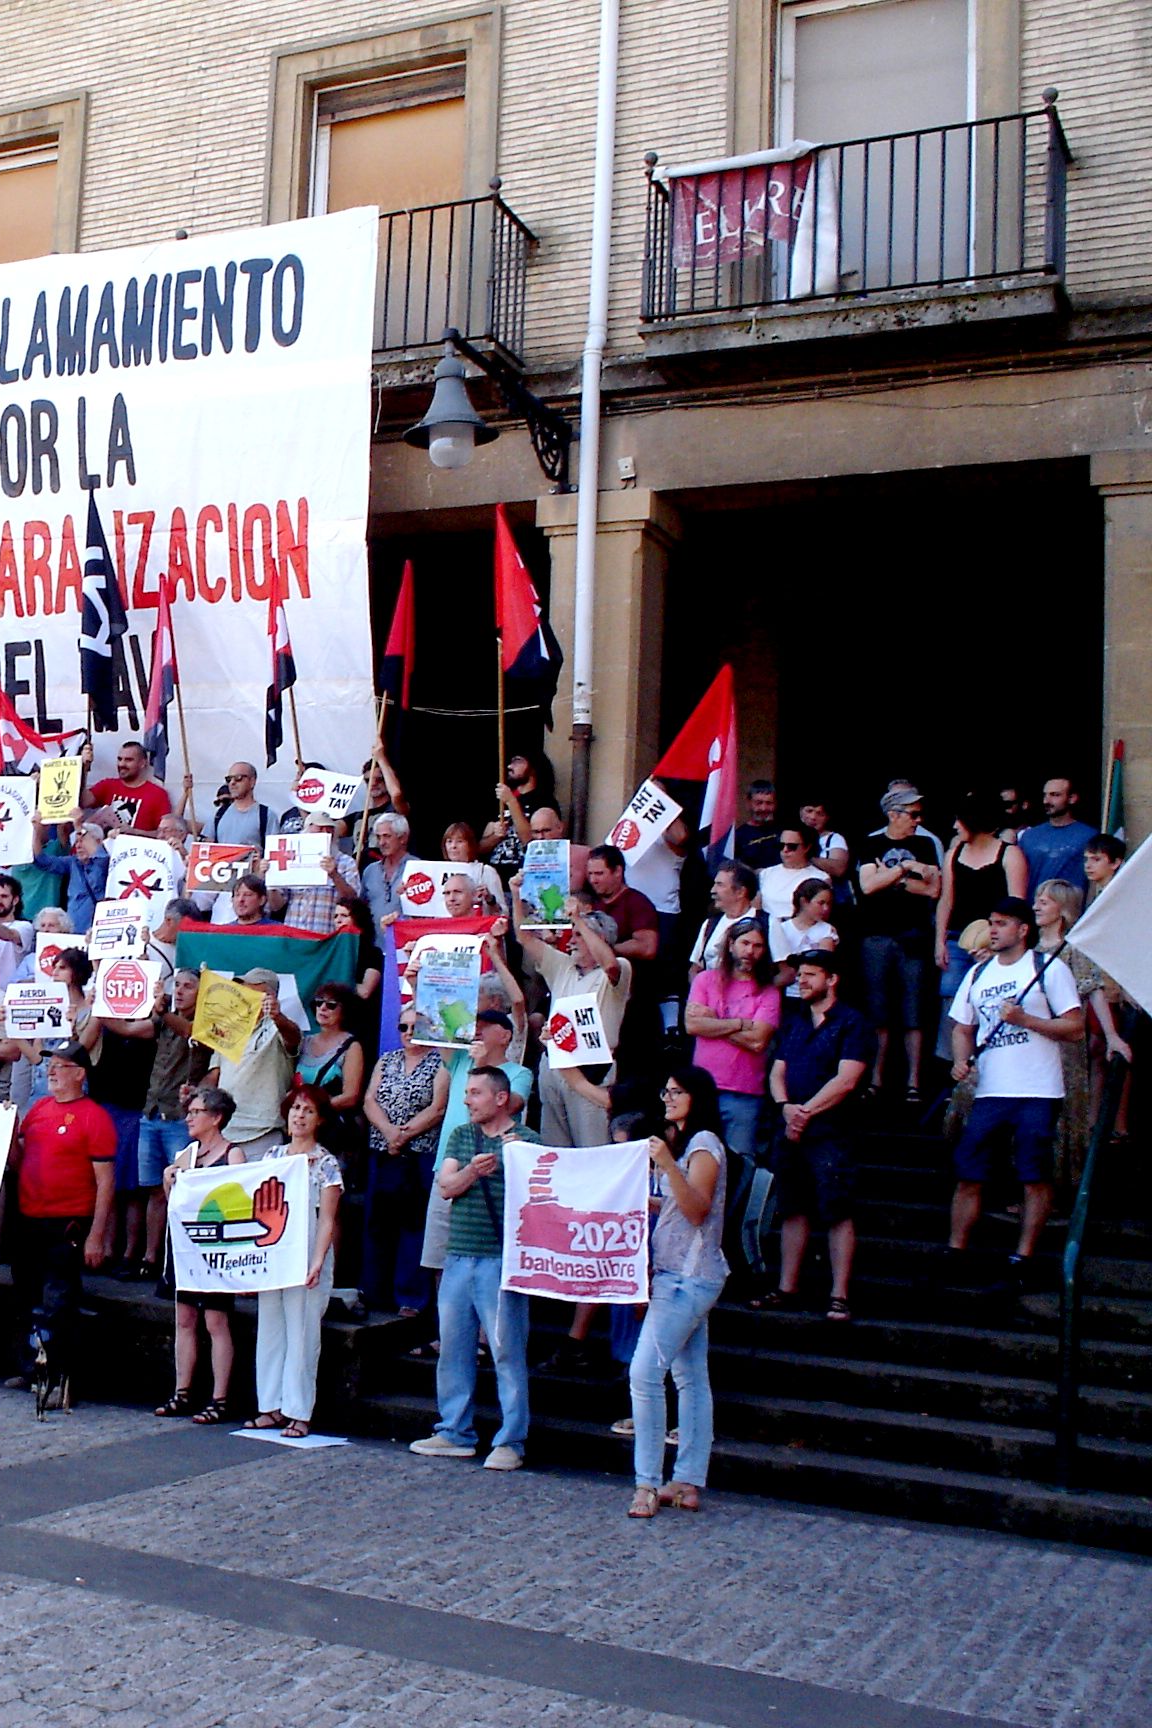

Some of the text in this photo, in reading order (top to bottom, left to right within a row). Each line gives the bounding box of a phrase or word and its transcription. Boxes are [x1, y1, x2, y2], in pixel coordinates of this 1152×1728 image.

[77, 392, 136, 490] LA
[298, 785, 324, 798] STOP
[332, 783, 357, 796] AHT
[631, 786, 653, 814] AHT
[329, 797, 349, 809] TAV
[642, 799, 666, 824] TAV
[616, 820, 633, 849] STOP
[194, 861, 250, 884] CGT
[406, 880, 433, 898] STOP
[107, 979, 144, 1000] STOP
[981, 980, 1017, 998] NEVER
[574, 1007, 595, 1027] AHT
[553, 1021, 574, 1045] STOP
[581, 1031, 601, 1049] TAV
[567, 1218, 642, 1253] 2028
